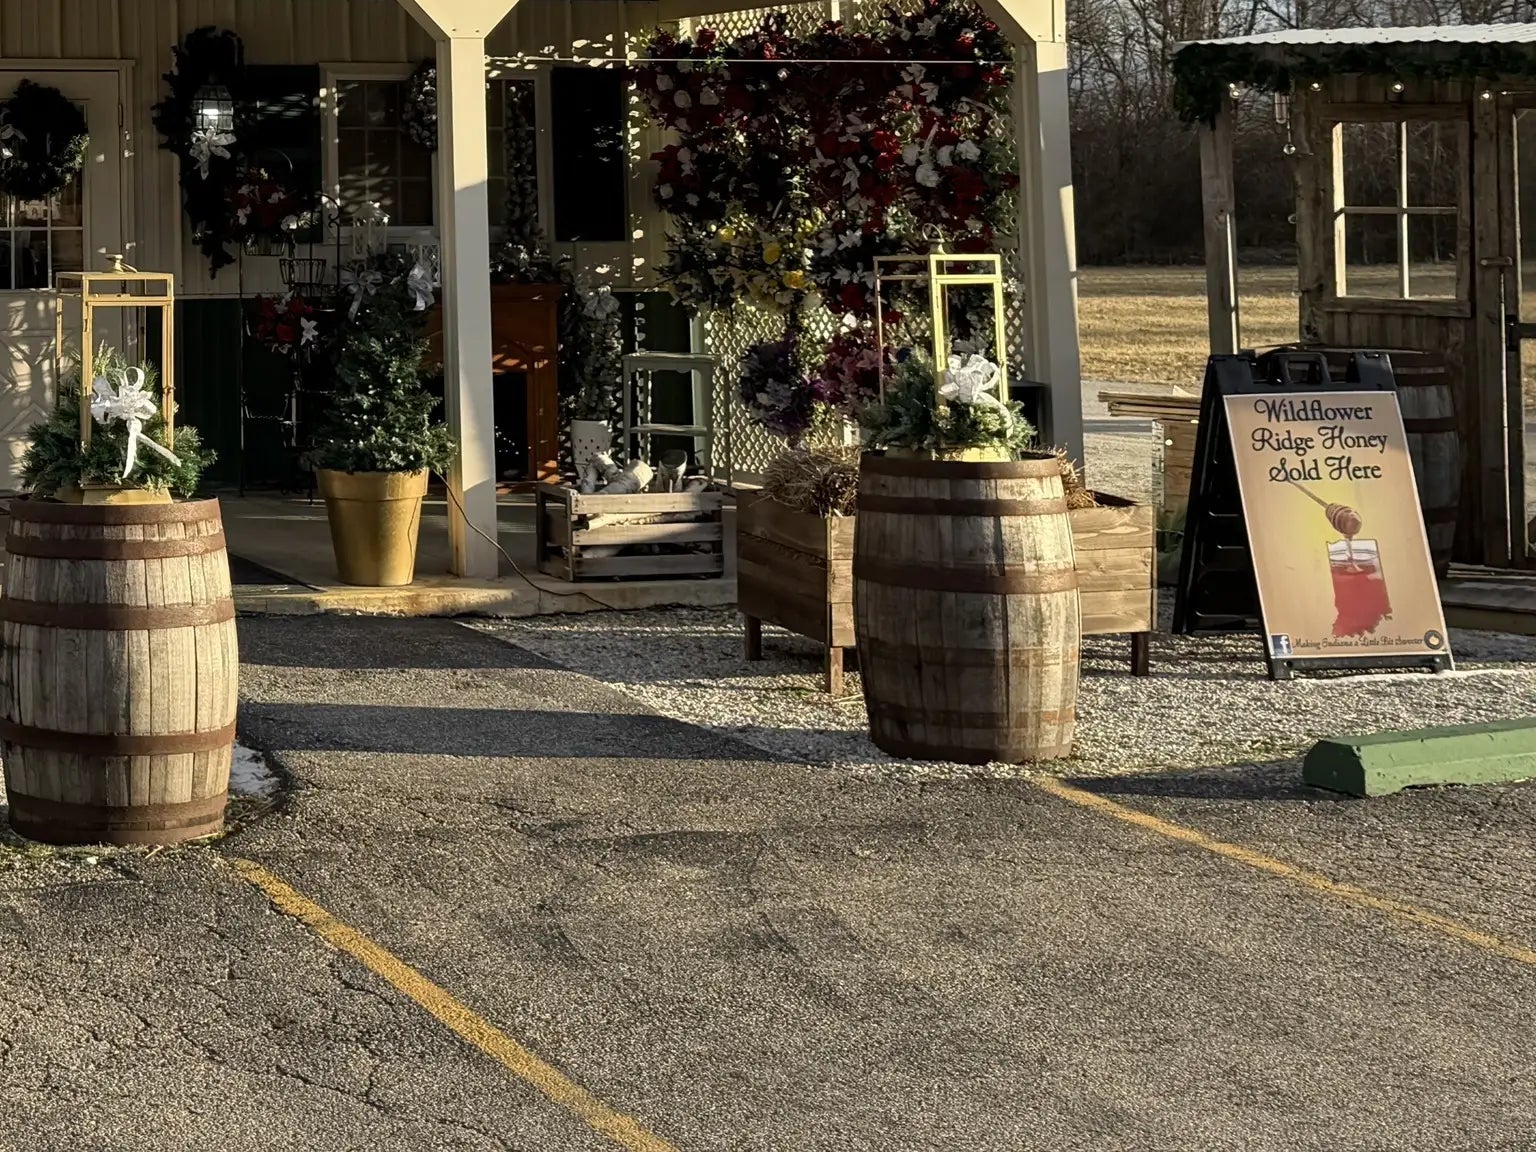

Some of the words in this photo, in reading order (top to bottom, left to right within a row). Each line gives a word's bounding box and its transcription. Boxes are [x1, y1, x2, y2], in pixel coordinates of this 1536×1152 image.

[1254, 398, 1373, 423] Wildflower
[1251, 427, 1315, 456] Ridge
[1317, 425, 1388, 454] Honey
[1269, 457, 1323, 483] Sold
[1324, 455, 1383, 481] Here
[1294, 637, 1321, 650] Making
